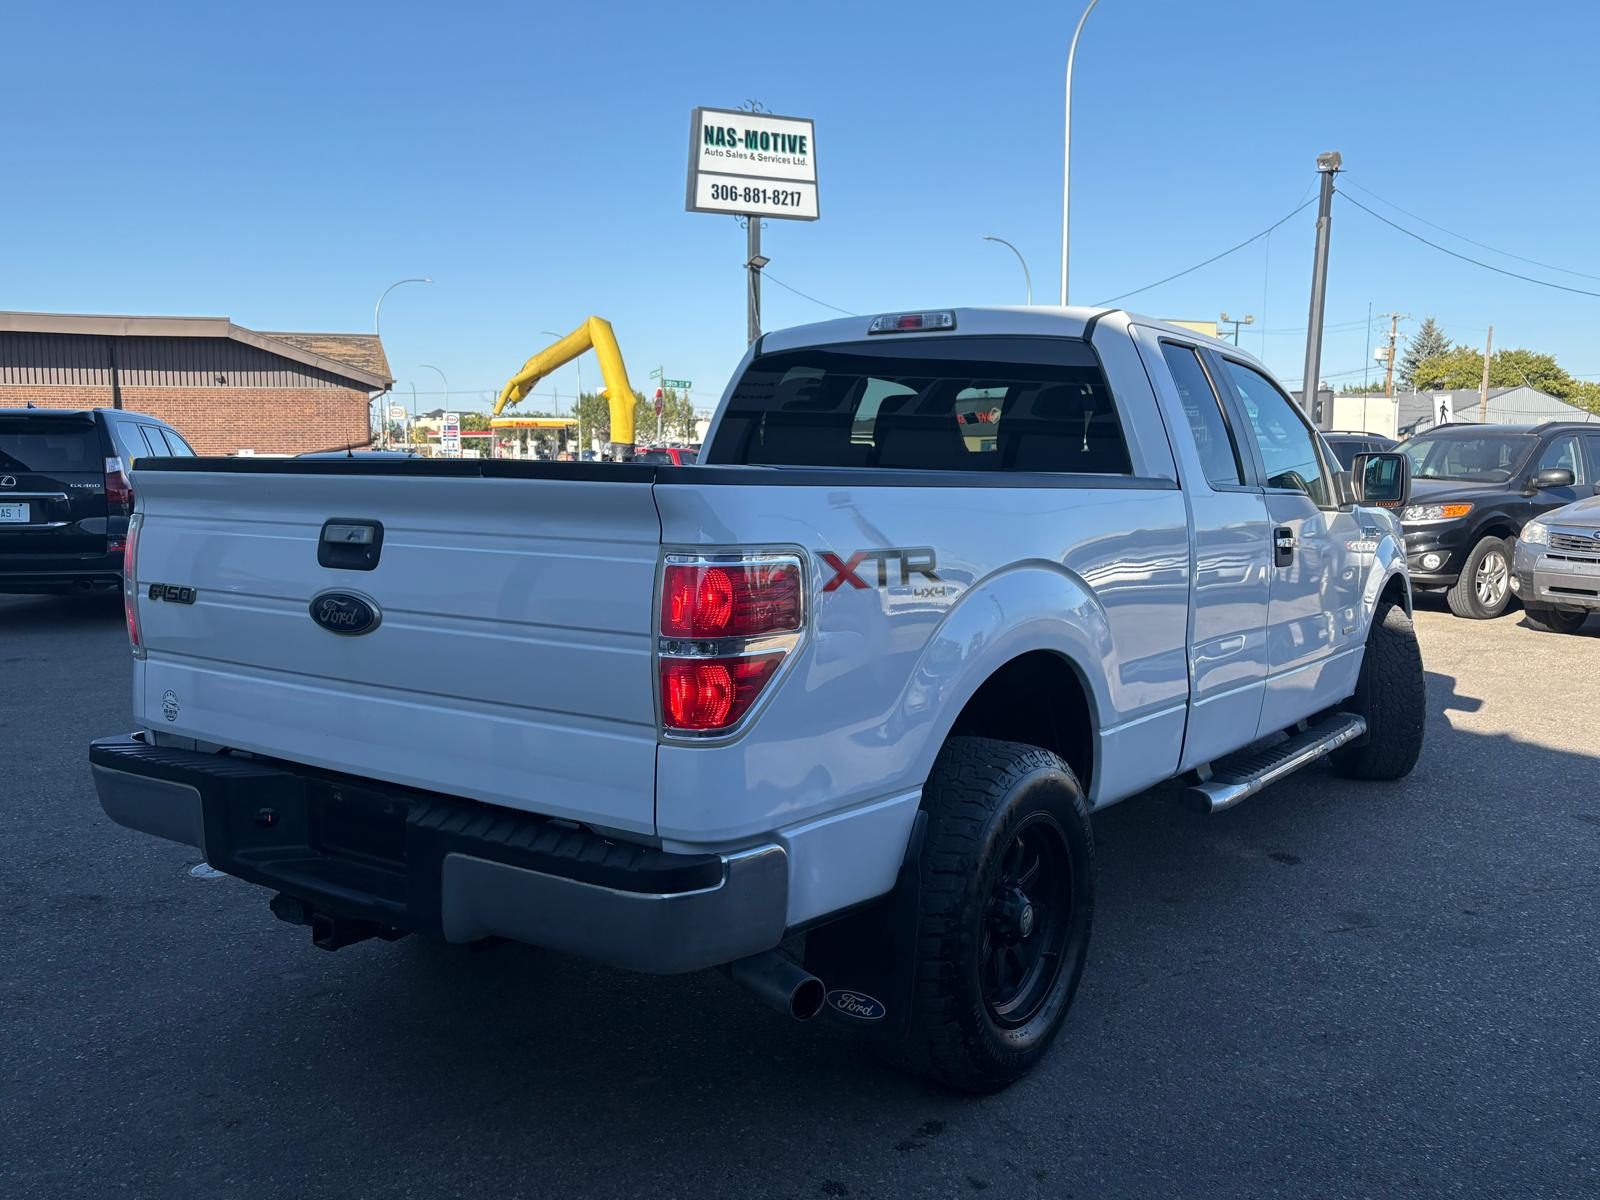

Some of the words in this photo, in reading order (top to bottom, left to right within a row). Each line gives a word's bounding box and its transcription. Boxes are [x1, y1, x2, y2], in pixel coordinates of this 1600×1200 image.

[703, 125, 807, 155] NAS-MOTIVE
[704, 148, 724, 157] Auto
[725, 150, 748, 160] Sales
[749, 152, 756, 161] &
[757, 153, 791, 165] Services
[792, 157, 808, 166] Ltd.
[711, 183, 802, 207] 306-881-8217
[816, 547, 945, 593] XTR
[320, 599, 358, 625] Ford
[837, 992, 874, 1017] Ford
